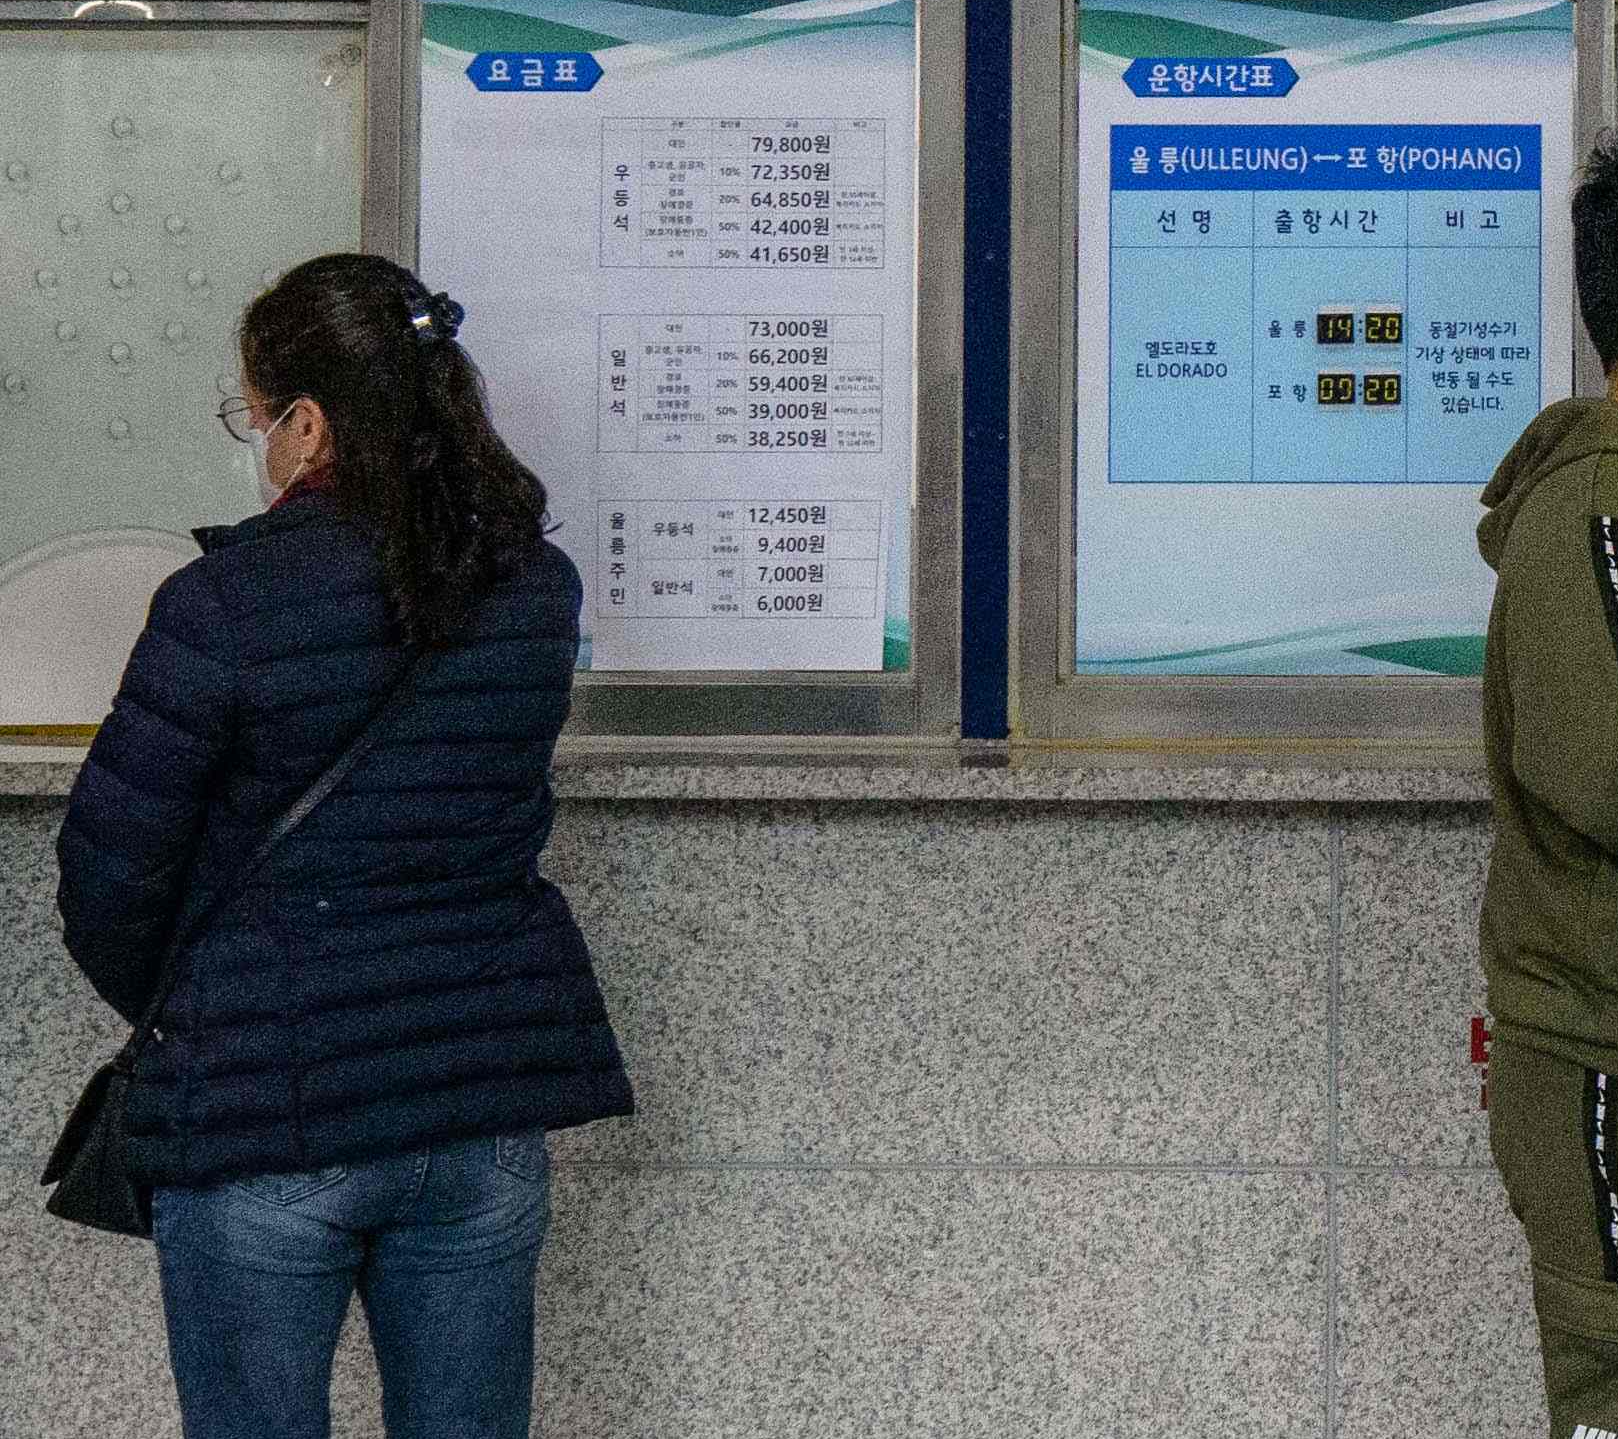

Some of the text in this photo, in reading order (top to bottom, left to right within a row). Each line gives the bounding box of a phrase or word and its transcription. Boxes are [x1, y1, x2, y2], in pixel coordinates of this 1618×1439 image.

[487, 58, 578, 88] 요금표
[1148, 63, 1274, 94] 운항시간표
[751, 134, 831, 155] 79,800원
[751, 162, 831, 182] 72,350원
[750, 189, 830, 209] 64,850원
[749, 216, 830, 237] 42,400원
[749, 244, 830, 265] 41,650원
[748, 319, 828, 339] 73,000원
[748, 346, 828, 367] 66,200원
[1144, 340, 1218, 359] 엘도라도호
[1415, 346, 1531, 365] 기상 상태에 따라
[1135, 362, 1228, 379] EL DORADO
[1431, 370, 1460, 390] 변동
[1485, 371, 1514, 388] 수도
[748, 374, 828, 394] 59,400원
[748, 401, 828, 421] 39,000원
[1441, 395, 1504, 415] 있습니다.
[747, 428, 827, 449] 38,250원
[748, 505, 826, 526] 12,450원
[757, 534, 825, 555] 9,400원
[757, 563, 824, 584] 7,000원
[756, 593, 823, 614] 6,000원
